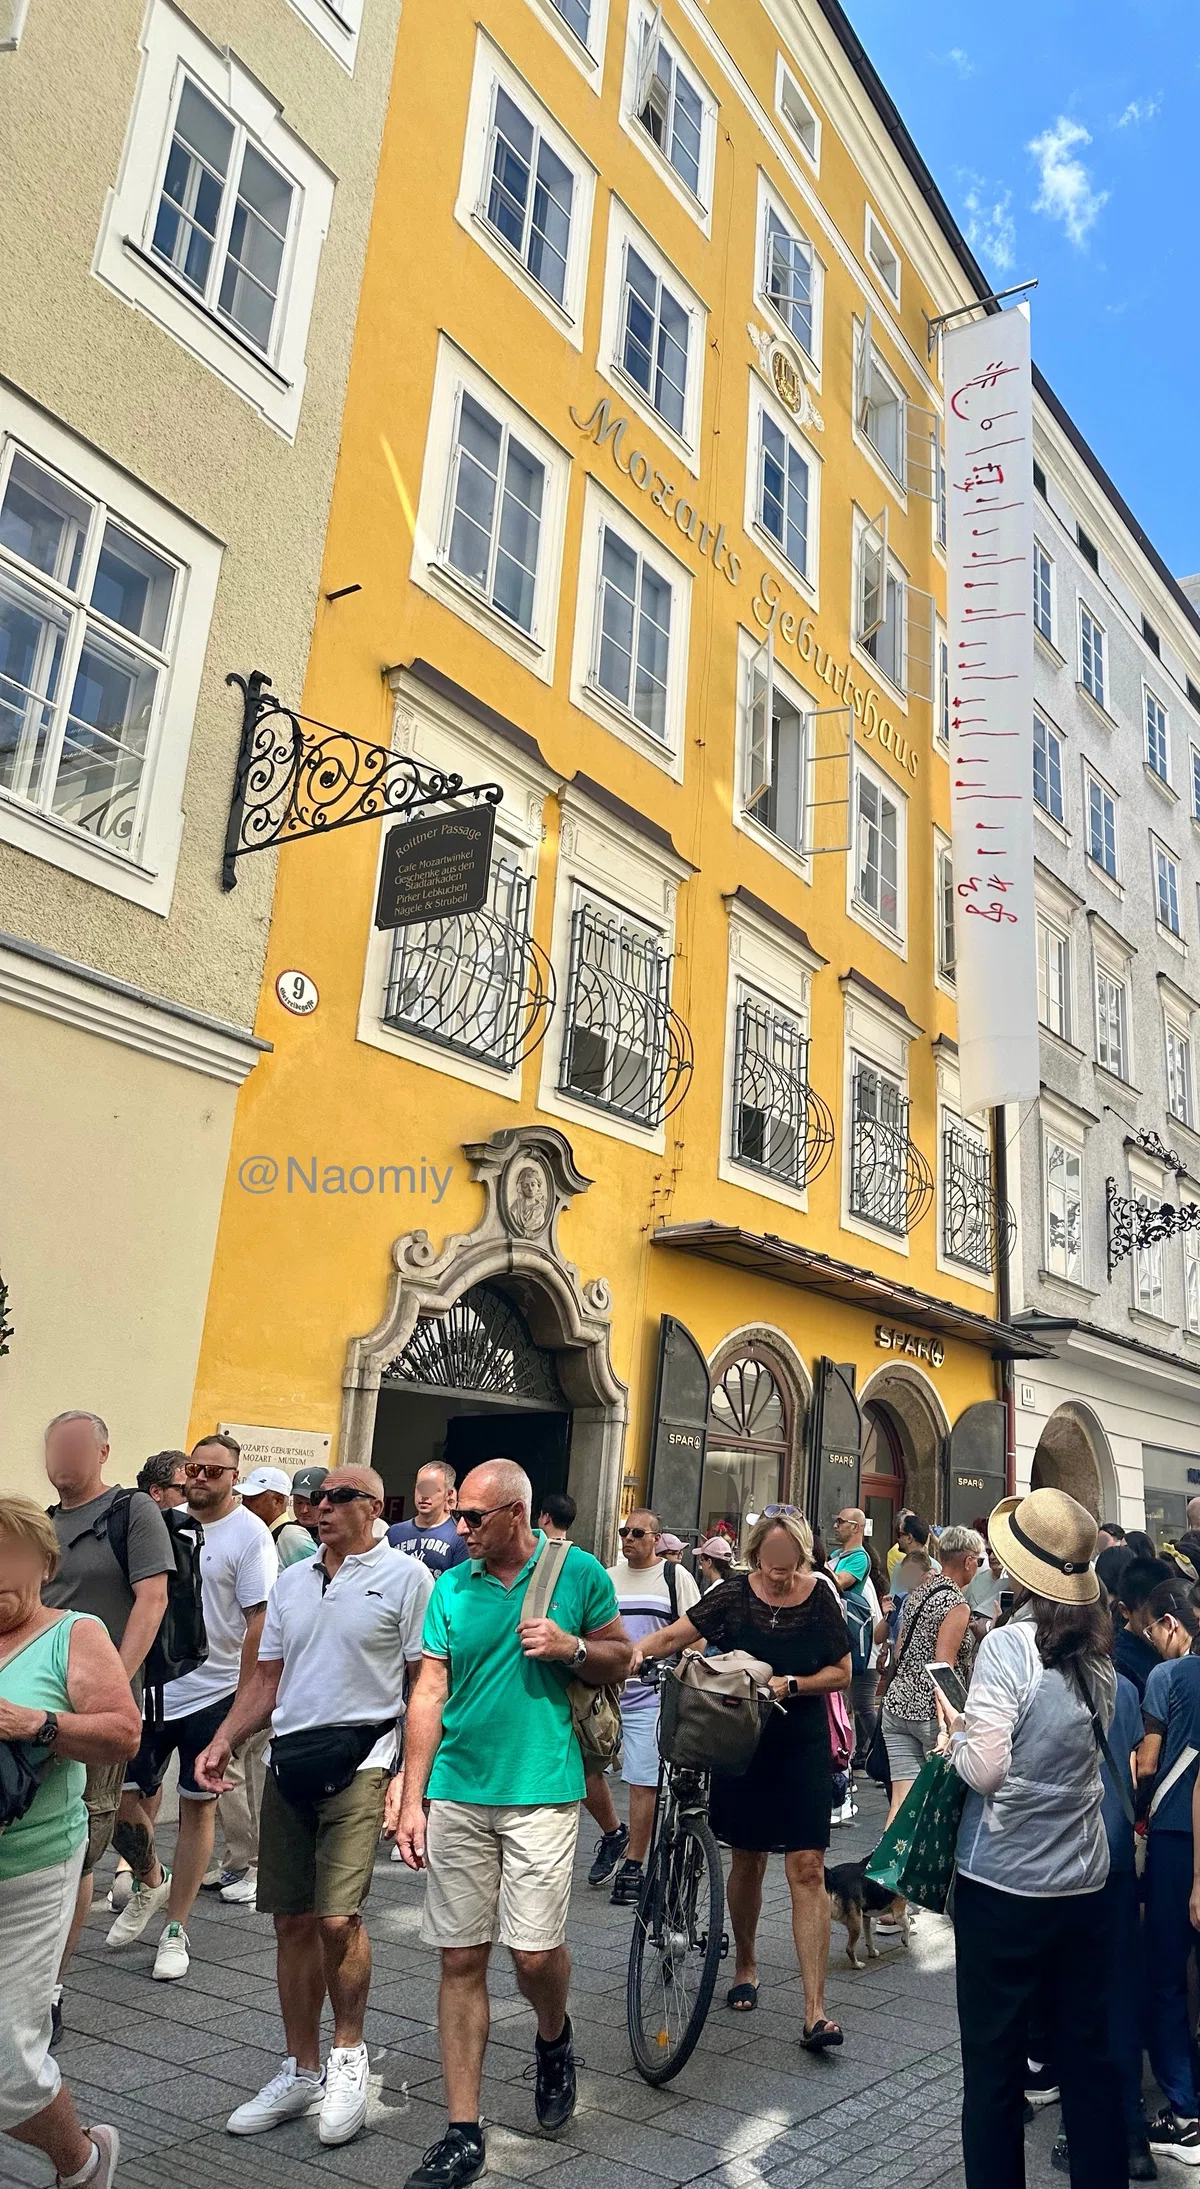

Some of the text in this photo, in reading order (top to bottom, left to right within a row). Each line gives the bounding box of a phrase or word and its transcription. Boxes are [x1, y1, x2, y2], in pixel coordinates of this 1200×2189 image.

[570, 397, 920, 779] Mozarts Geburtshaus
[395, 824, 481, 858] Roittner Passage
[398, 849, 474, 874] Cafe Mozartwinkel
[394, 861, 475, 885] Geschenke aus den
[405, 872, 462, 891] Stadtarkaden
[396, 883, 468, 905] Pirker Lebkuchen
[394, 893, 468, 917] Nägele & Strubell
[292, 976, 305, 1000] 9
[875, 1325, 931, 1360] SPAR
[1025, 1388, 1032, 1399] 11
[668, 1433, 694, 1447] SPAR
[242, 1454, 272, 1463] MOZART
[278, 1456, 307, 1465] MUSEUM
[270, 1446, 315, 1457] GEBURTSHAUS
[829, 1454, 849, 1465] SPAR
[957, 1477, 978, 1487] SPAR
[420, 1537, 450, 1556] YORK
